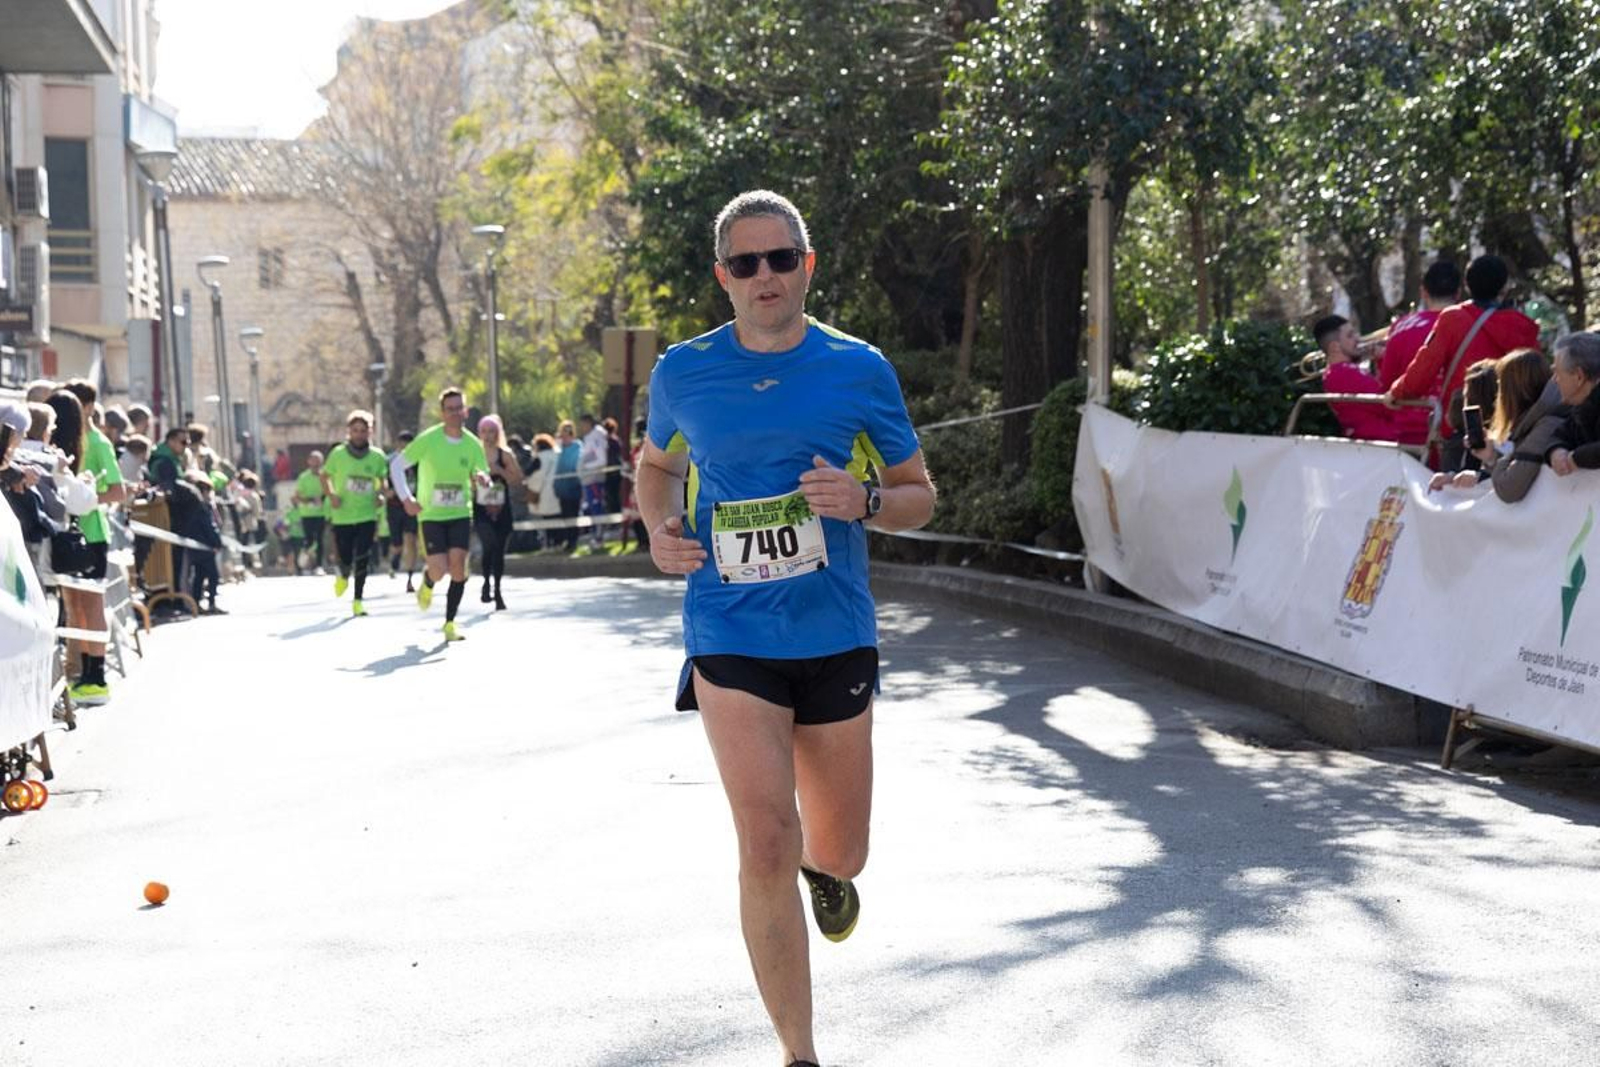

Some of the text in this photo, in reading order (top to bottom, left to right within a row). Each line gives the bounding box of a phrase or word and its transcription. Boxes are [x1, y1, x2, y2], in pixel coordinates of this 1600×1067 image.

[743, 502, 760, 515] JUAN
[762, 500, 783, 513] BOSCO
[752, 511, 779, 526] POPULAR
[736, 525, 799, 564] 740
[1518, 646, 1555, 668] Patronato
[1556, 653, 1589, 676] Municipal
[1526, 667, 1558, 688] Deportes
[1557, 676, 1568, 691] de
